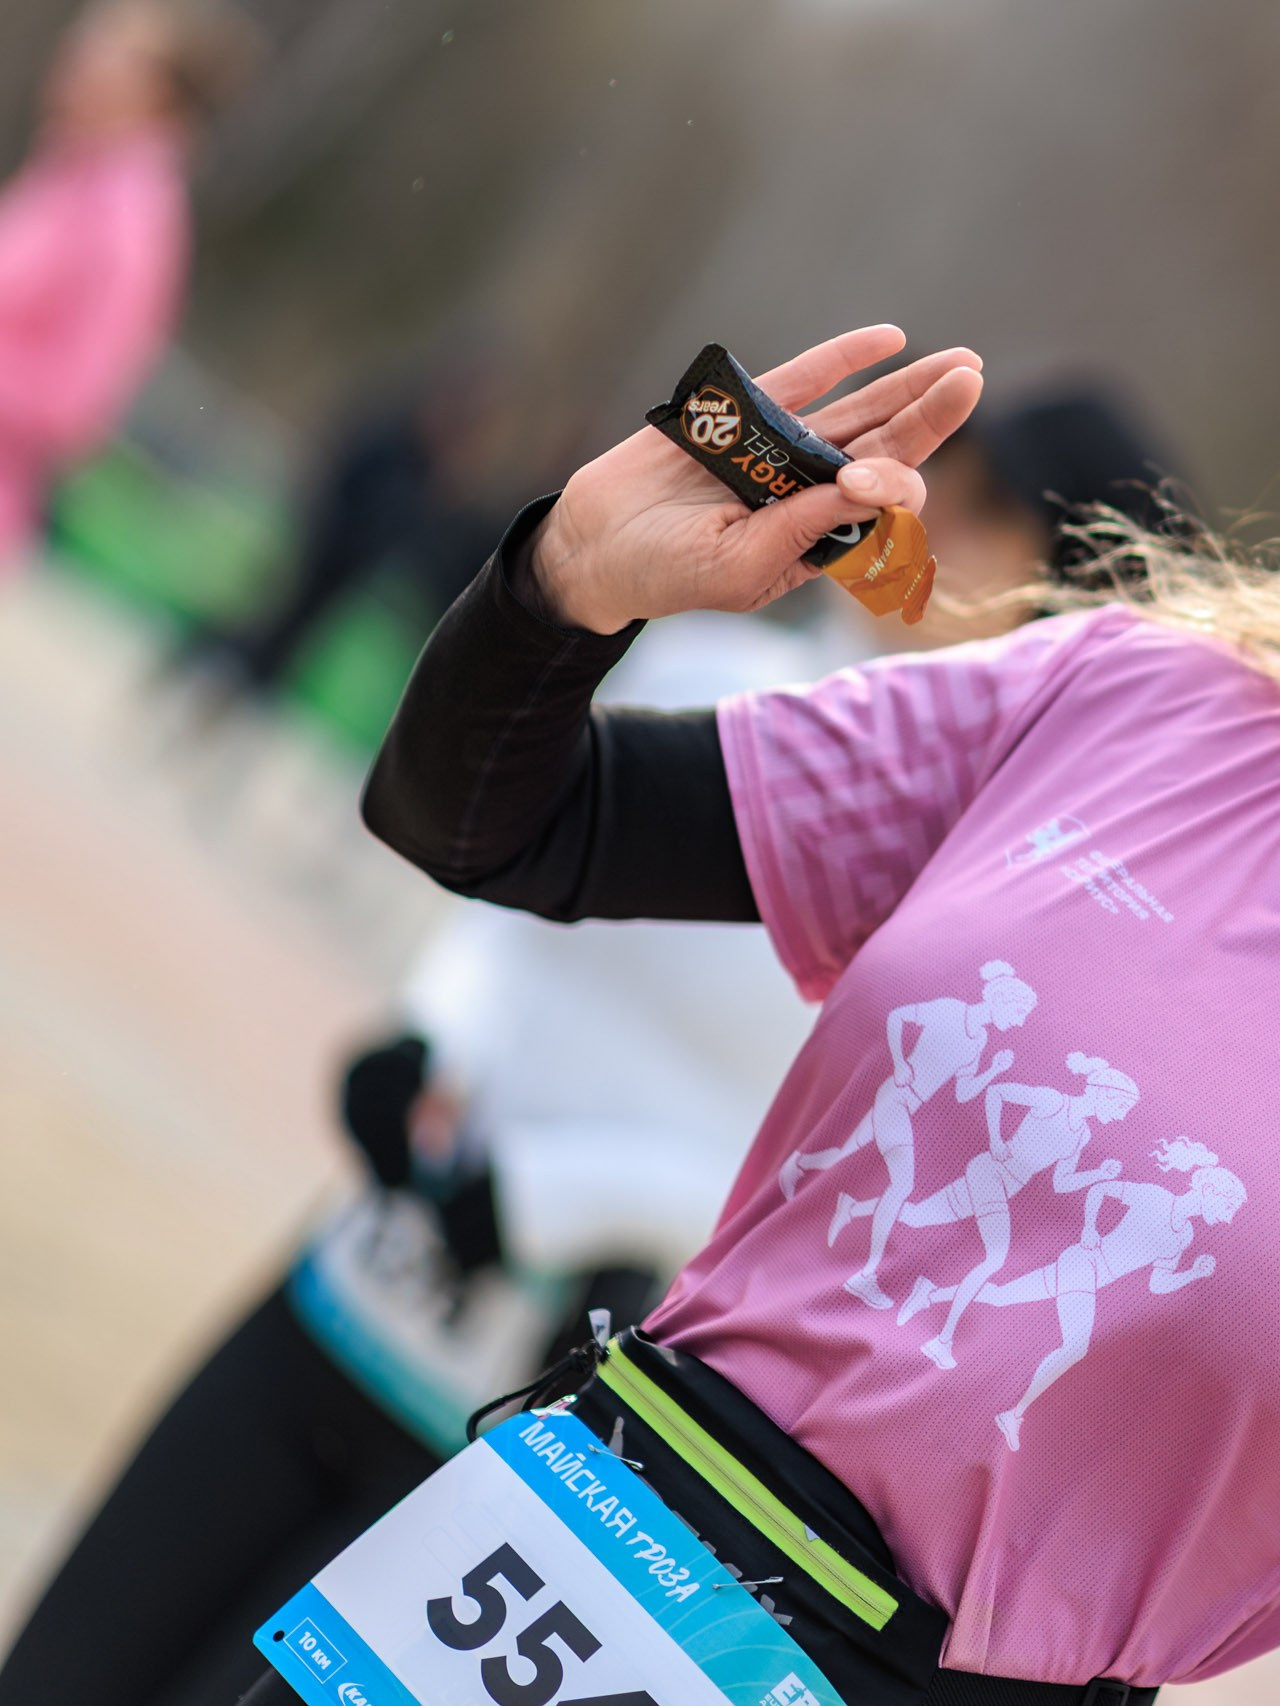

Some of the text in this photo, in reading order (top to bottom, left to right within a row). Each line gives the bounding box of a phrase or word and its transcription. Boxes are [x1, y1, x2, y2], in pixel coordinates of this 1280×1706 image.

[687, 399, 731, 414] years
[690, 413, 741, 447] 20
[743, 424, 790, 467] GEL
[864, 537, 895, 582] ORANGE
[518, 1421, 701, 1603] МАЙСКАЯ ГРОЗА
[298, 1631, 317, 1651] 10
